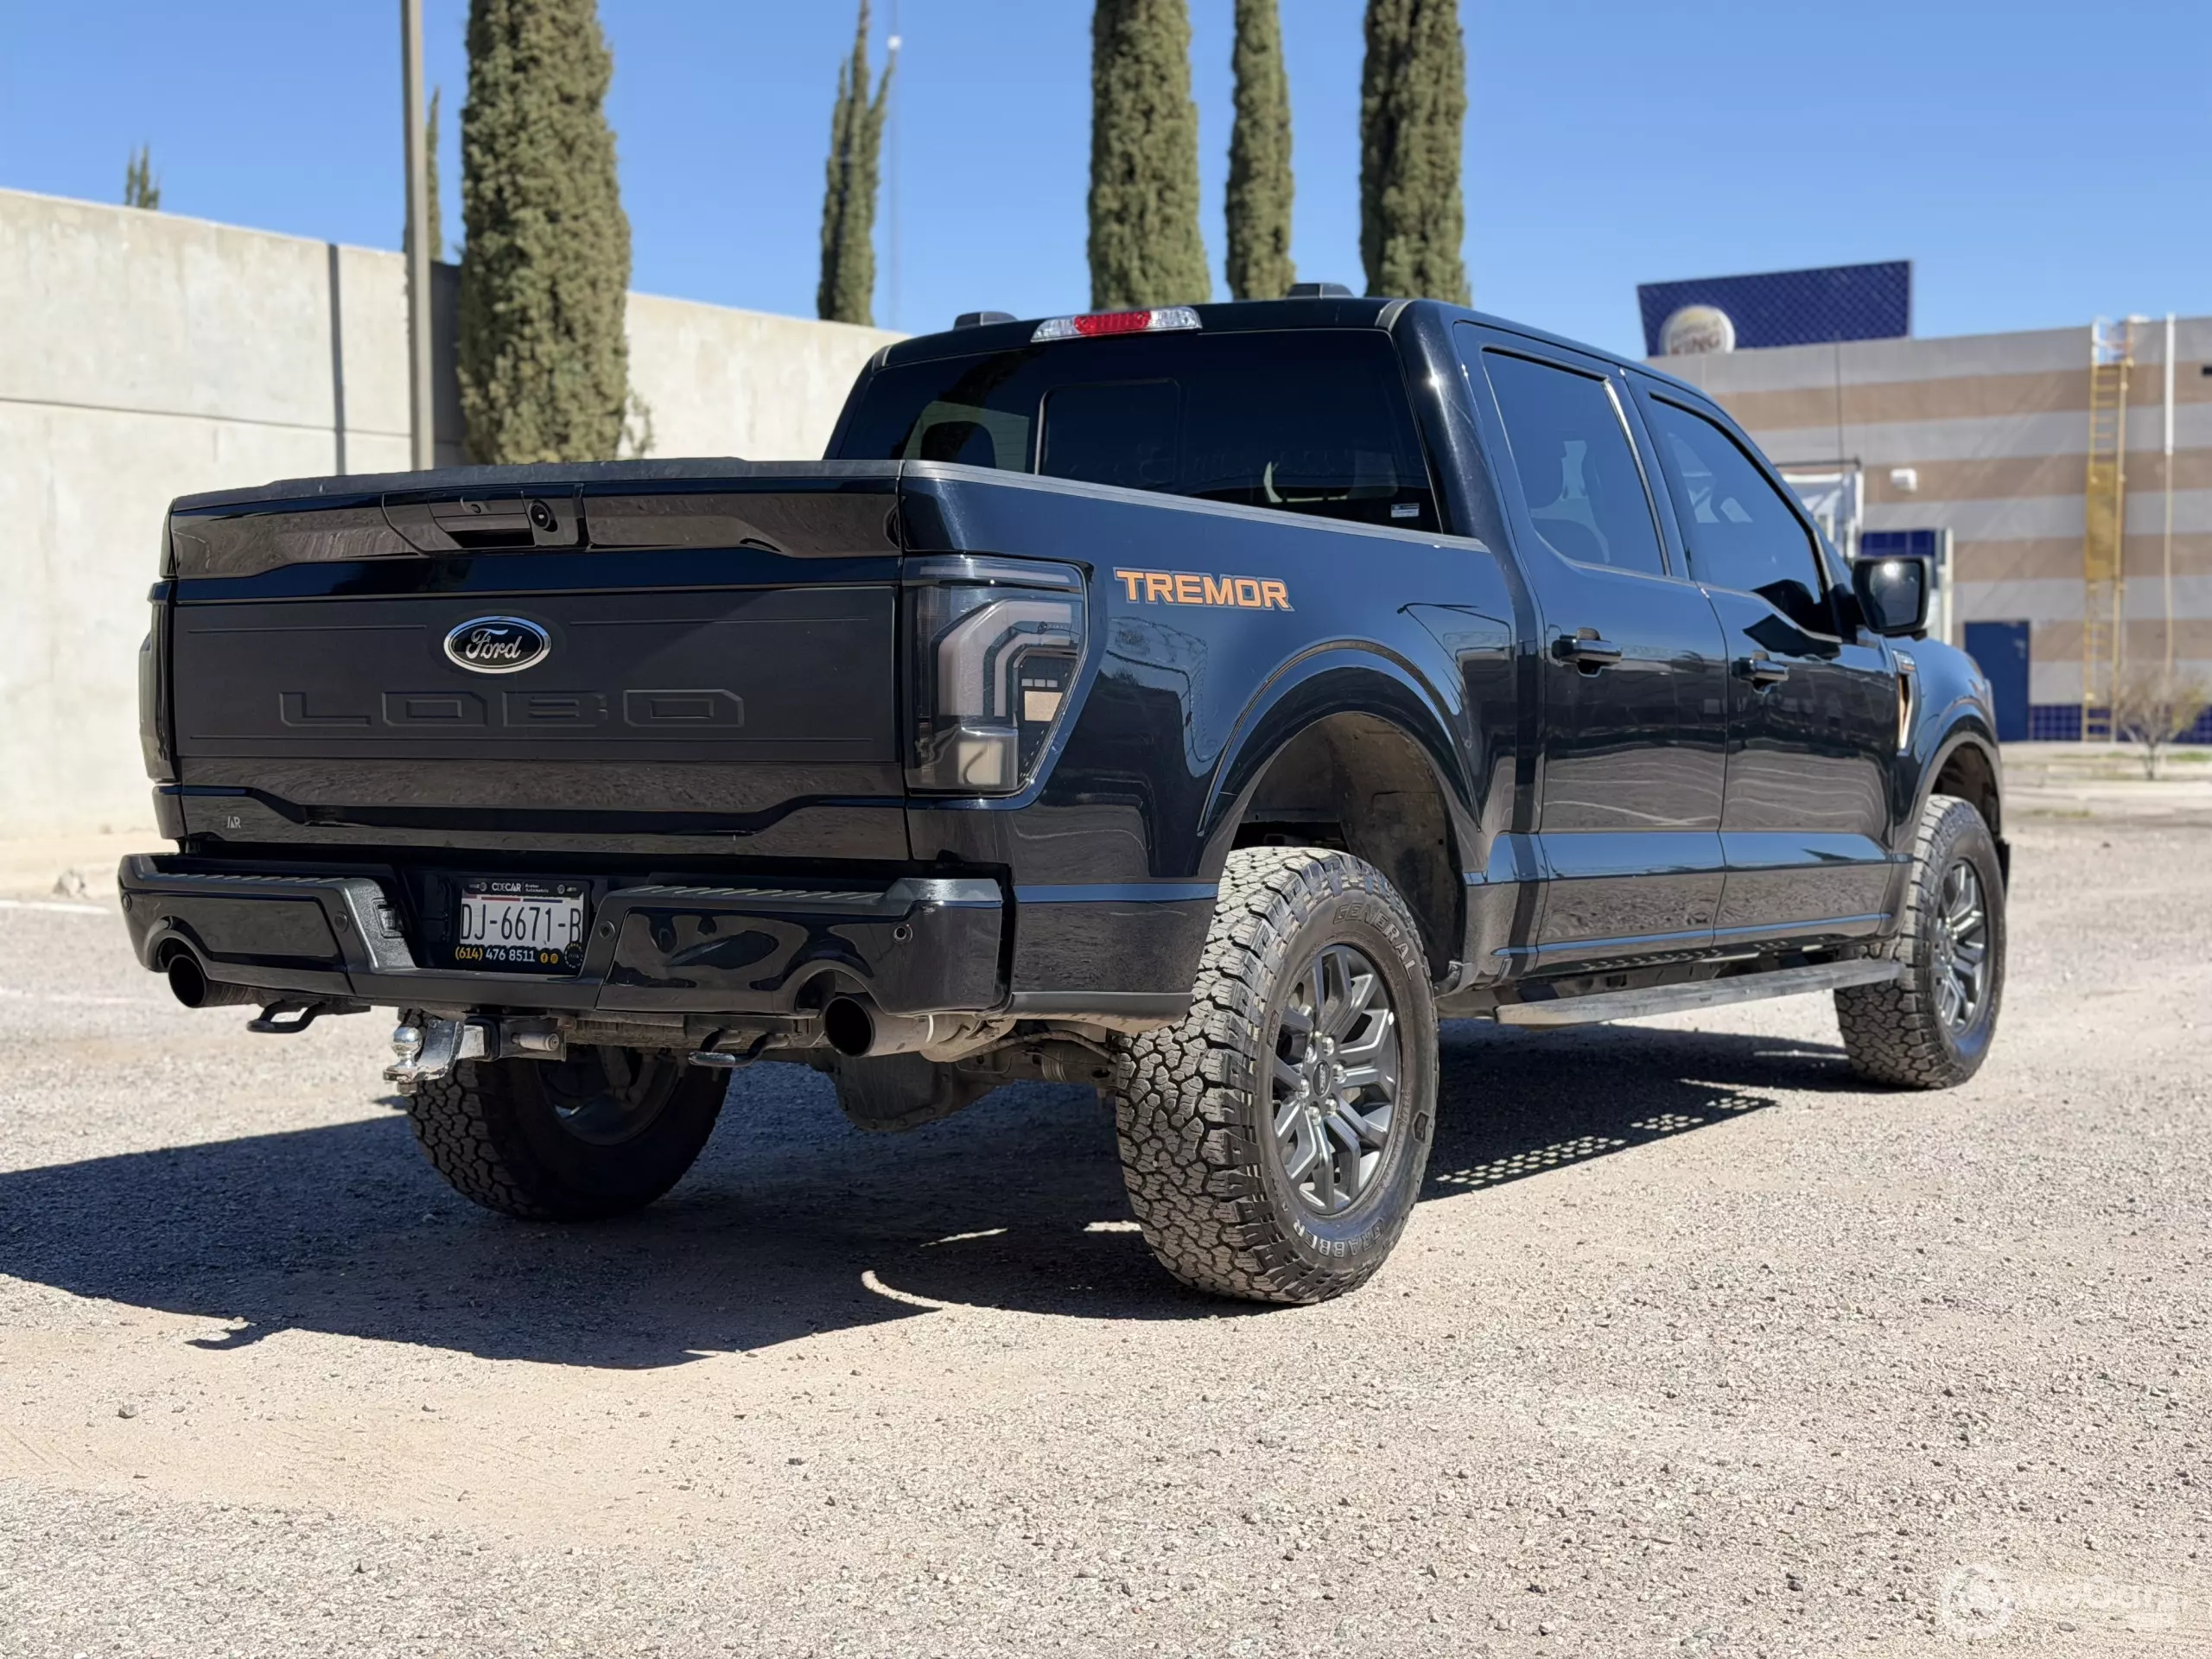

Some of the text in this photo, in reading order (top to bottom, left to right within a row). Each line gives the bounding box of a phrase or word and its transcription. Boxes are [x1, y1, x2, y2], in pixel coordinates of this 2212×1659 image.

[1113, 566, 1295, 612] TREMOR
[466, 628, 523, 659] Ford
[279, 690, 745, 728] LOBO
[461, 903, 582, 944] DJ-6671-B
[1332, 902, 1415, 981] GENERAL
[454, 946, 536, 963] (614) 476 8511
[1293, 1217, 1384, 1258] GRABBER
